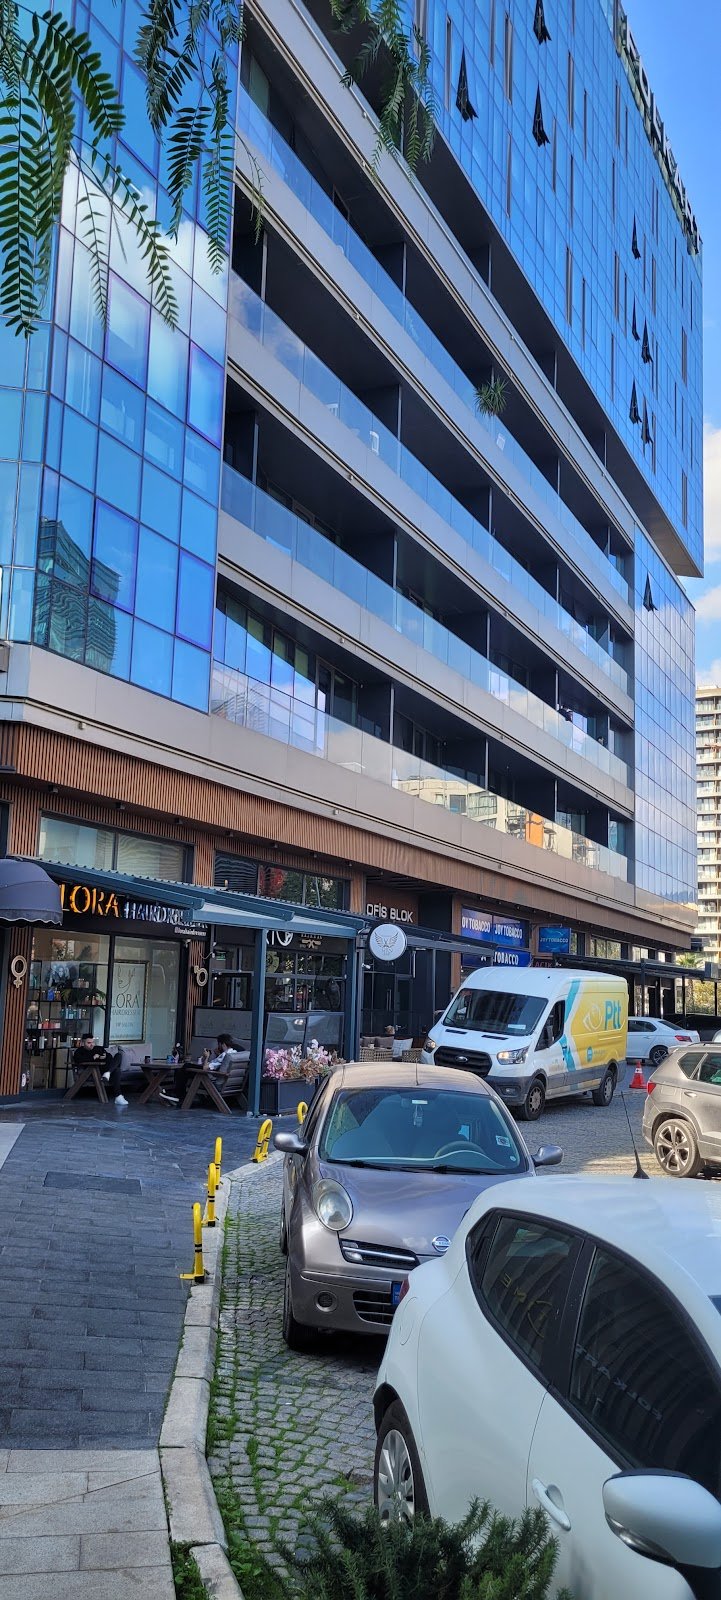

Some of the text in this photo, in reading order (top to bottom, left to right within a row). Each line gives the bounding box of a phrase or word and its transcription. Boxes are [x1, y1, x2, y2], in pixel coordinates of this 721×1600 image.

[60, 883, 119, 918] LORA
[390, 907, 414, 923] BLOK
[469, 918, 491, 933] TOBACCO
[494, 924, 523, 939] JOY TOBACCO
[603, 1000, 622, 1032] Ptt
